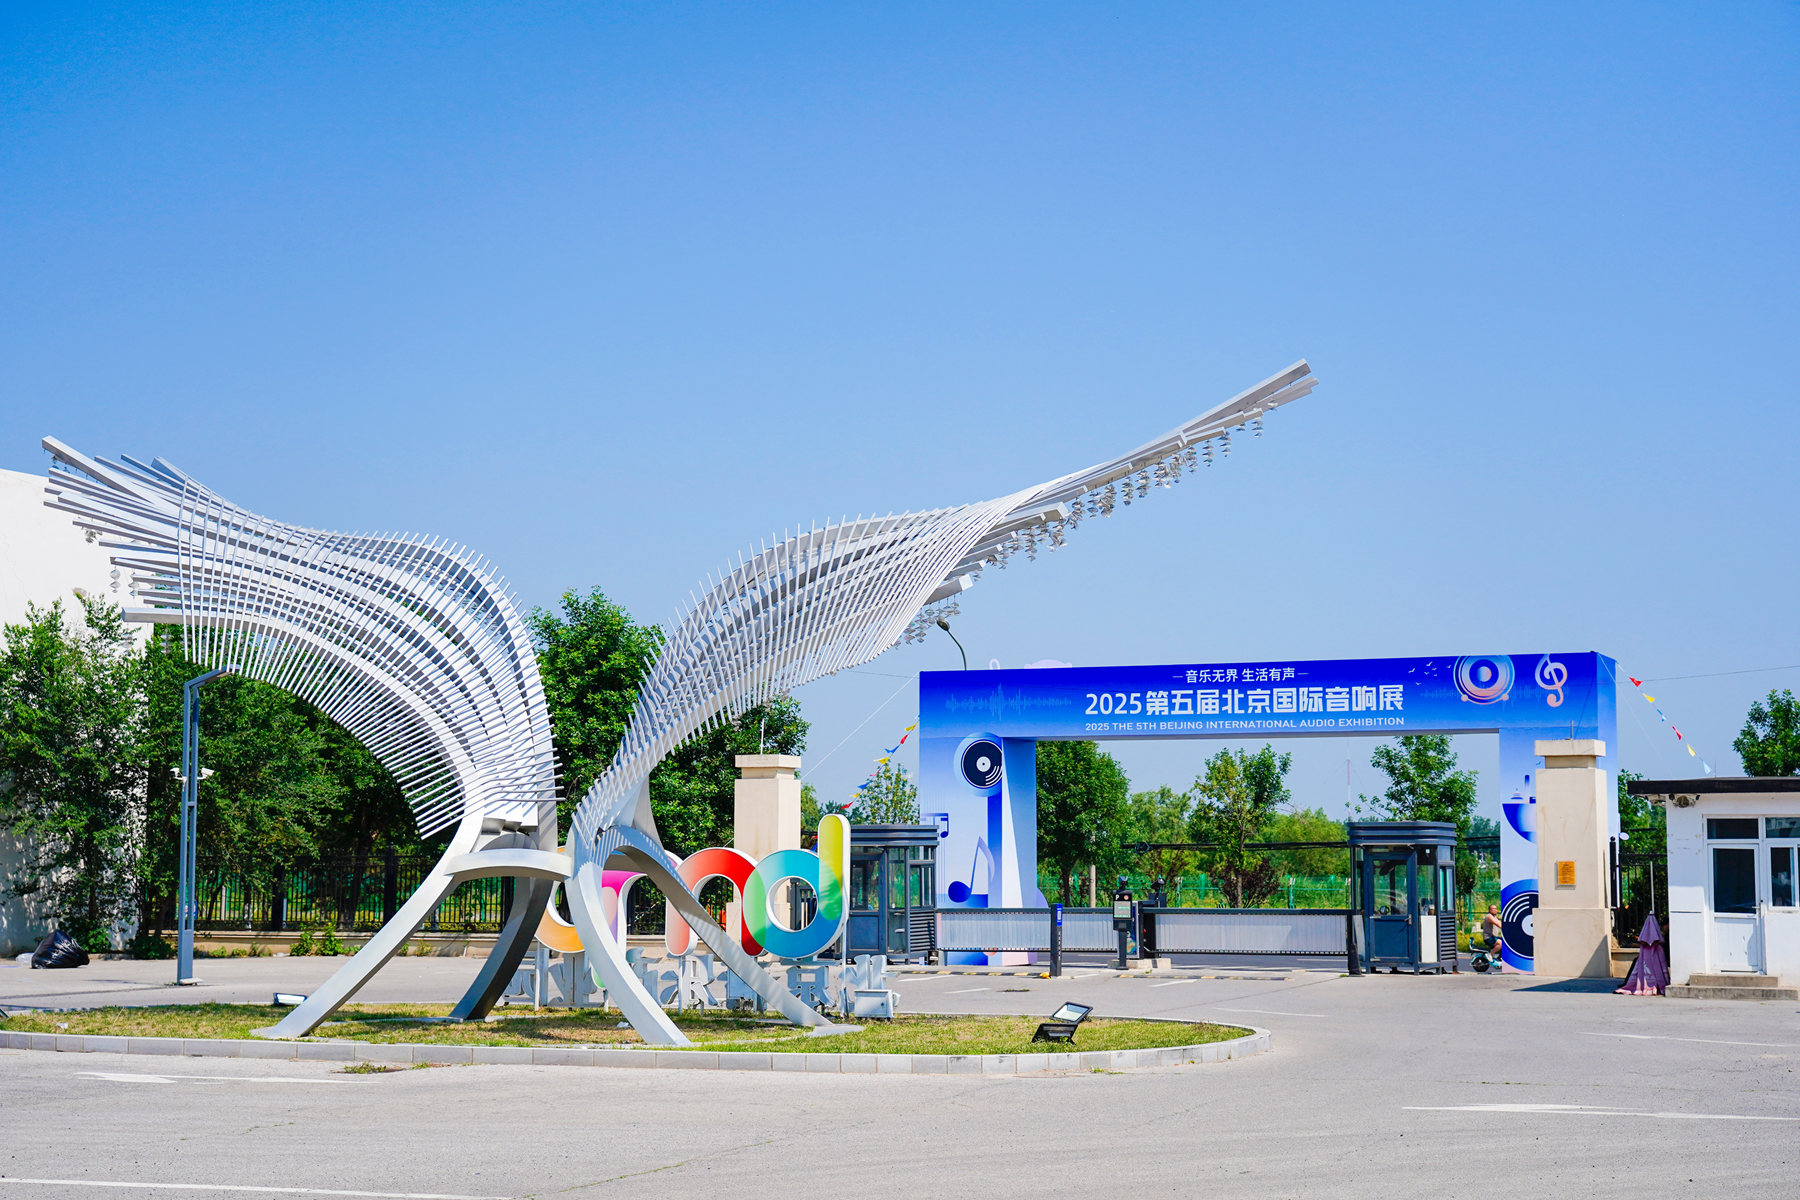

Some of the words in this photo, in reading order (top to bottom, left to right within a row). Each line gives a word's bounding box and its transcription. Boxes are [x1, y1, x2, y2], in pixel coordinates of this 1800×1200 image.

[1185, 669, 1239, 683] 音乐无界
[1241, 667, 1296, 682] 生活有声
[1085, 722, 1110, 731] 2025
[1112, 722, 1134, 731] THE
[1136, 721, 1157, 731] 5TH
[1159, 721, 1203, 730] BEIJING
[1206, 719, 1297, 730] INTERNATIONAL
[1299, 718, 1336, 728] AUDIO
[1338, 717, 1405, 727] EXHIBITION
